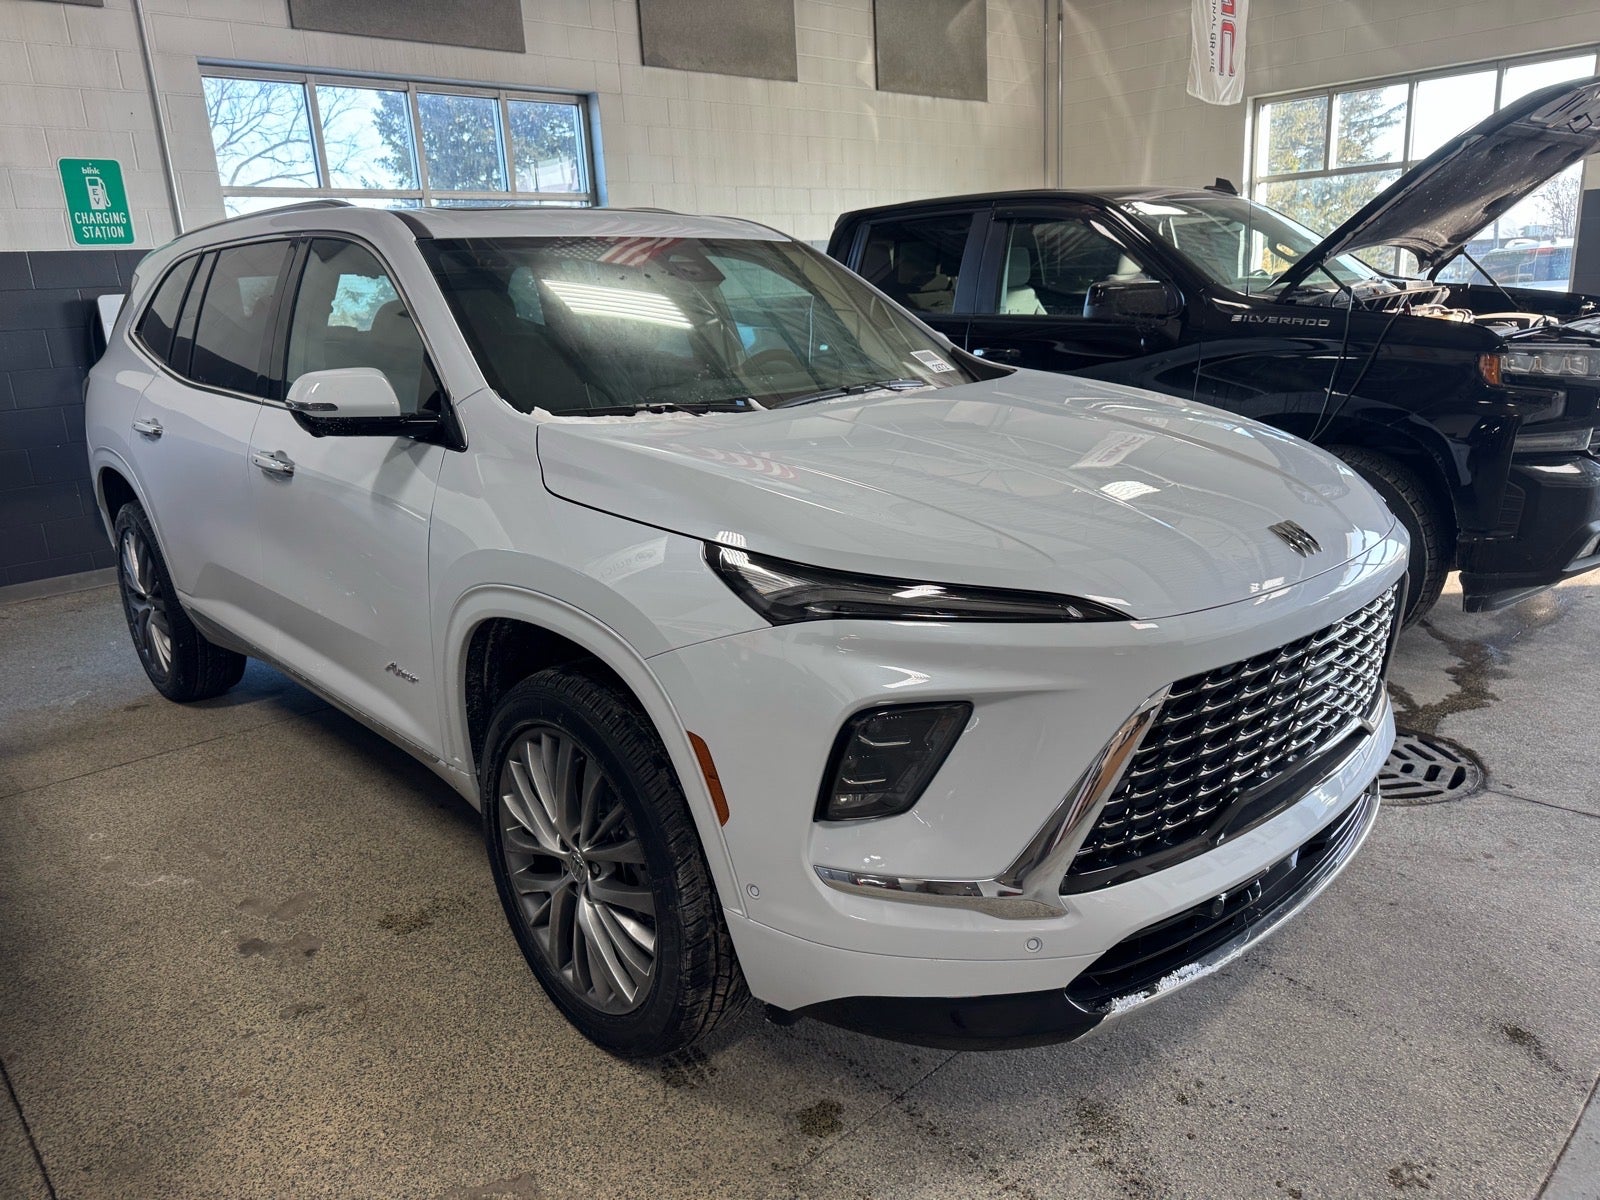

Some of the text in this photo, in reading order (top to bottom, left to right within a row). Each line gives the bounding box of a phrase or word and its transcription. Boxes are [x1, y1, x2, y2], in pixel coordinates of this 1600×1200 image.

[74, 212, 127, 224] CHARGING
[82, 226, 125, 239] STATION
[1231, 314, 1331, 327] SILVERADO
